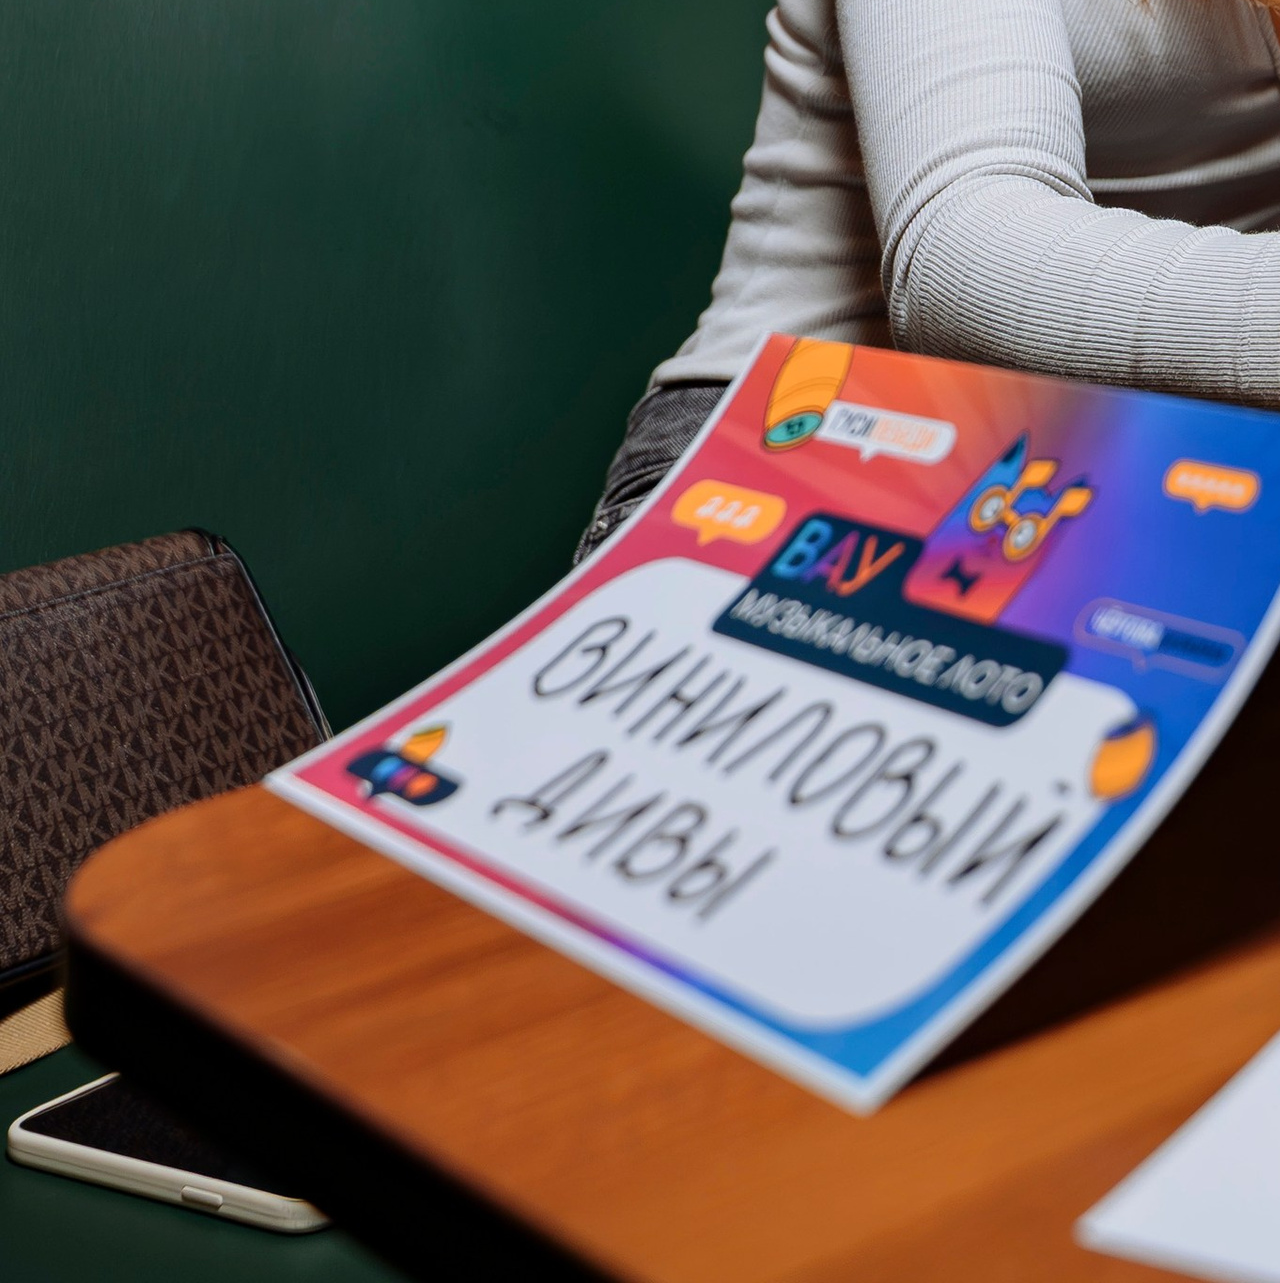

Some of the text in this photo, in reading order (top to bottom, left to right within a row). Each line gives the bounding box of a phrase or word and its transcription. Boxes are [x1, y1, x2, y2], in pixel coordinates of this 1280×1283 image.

[772, 520, 905, 596] ВАУ
[729, 588, 1044, 715] МУЗЫКАЛЬНОЕ ЛОТО
[490, 748, 777, 923] ДИВЫ
[533, 615, 1075, 908] ВИНИЛОВЫЙ
